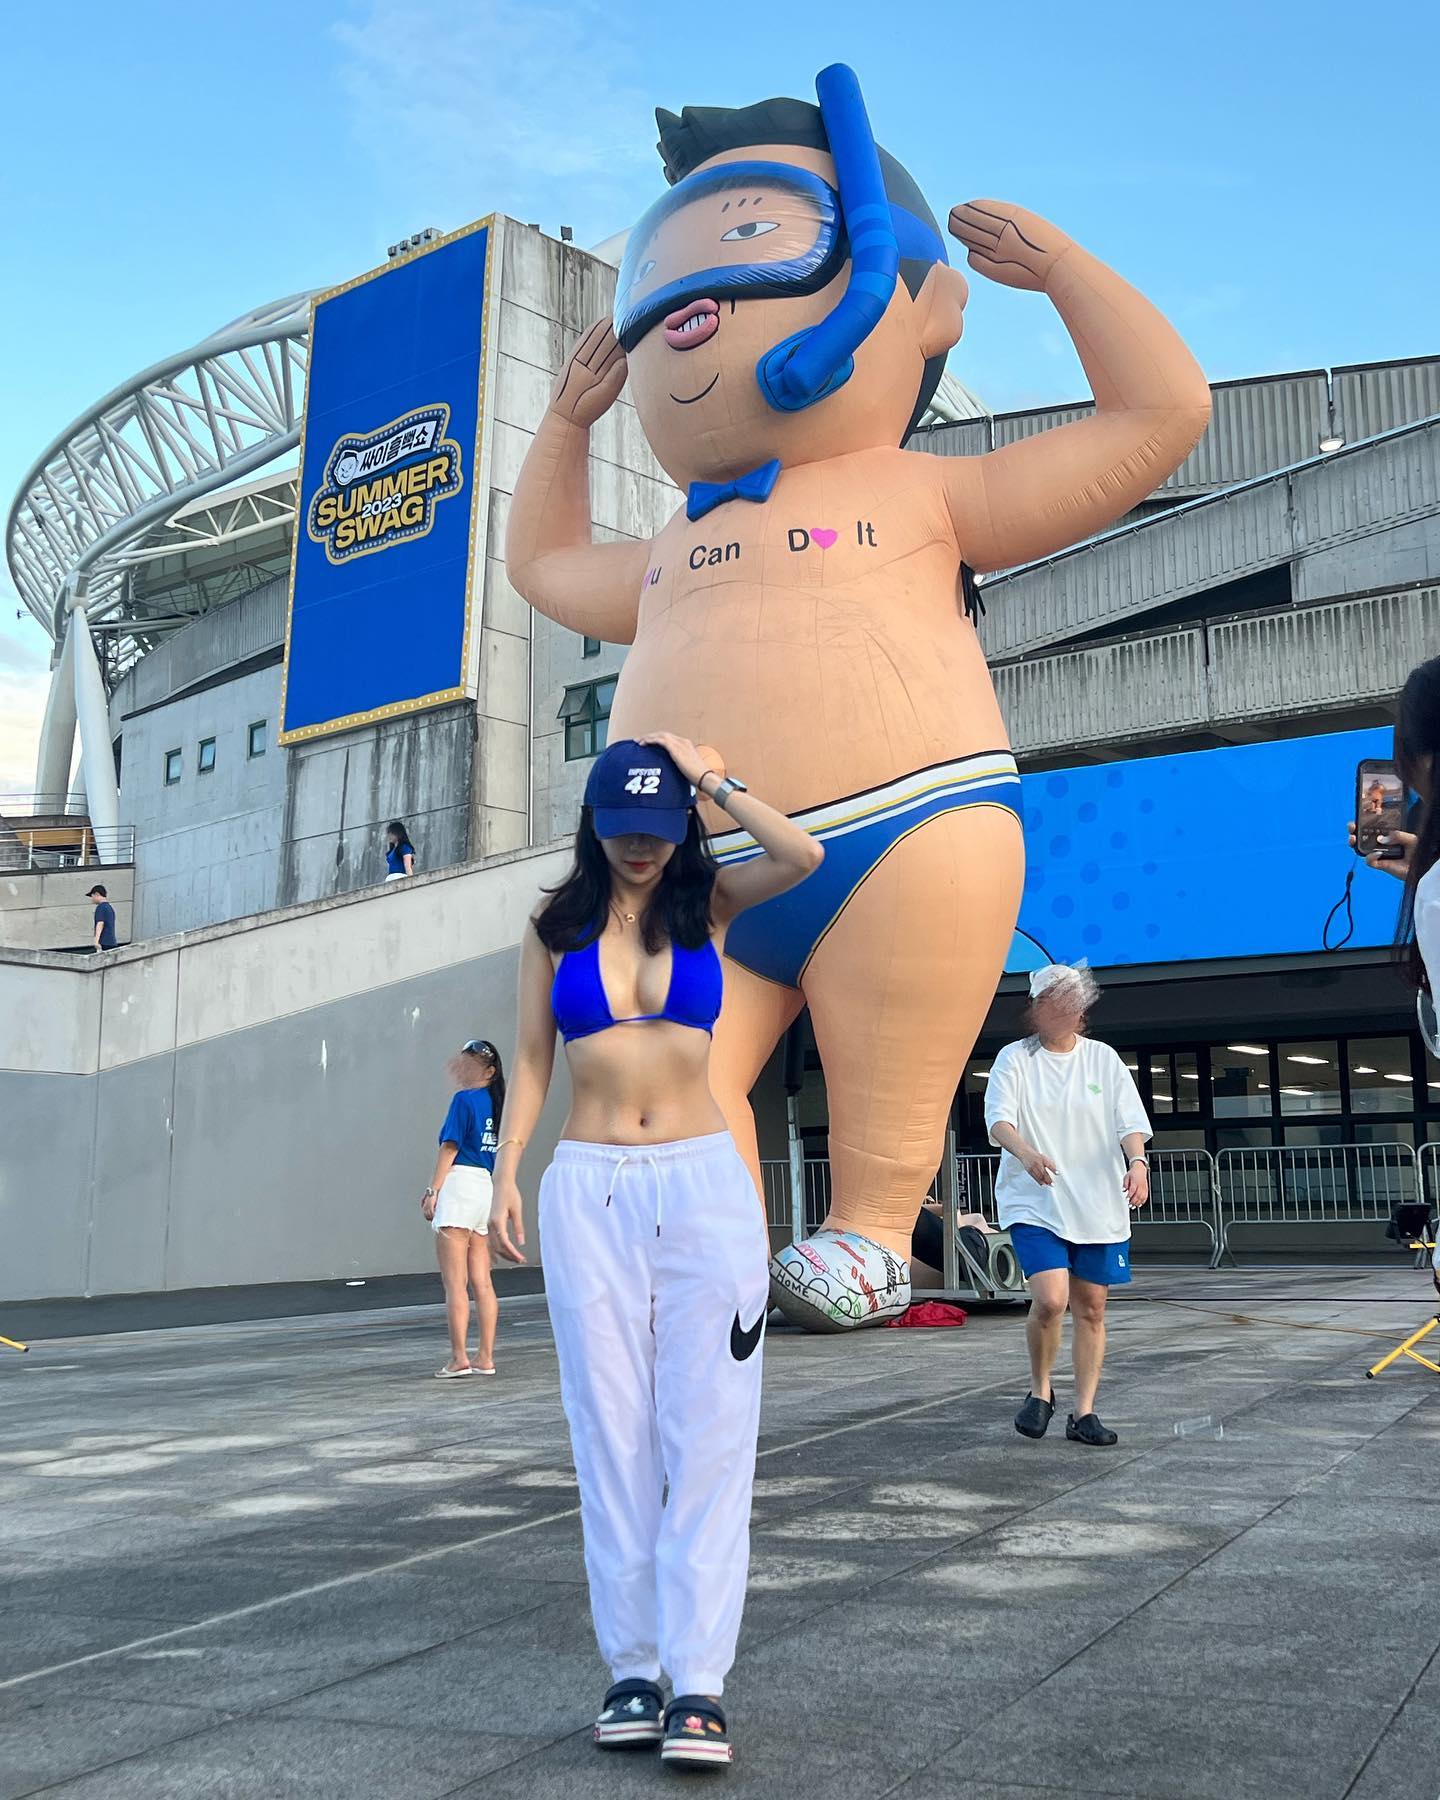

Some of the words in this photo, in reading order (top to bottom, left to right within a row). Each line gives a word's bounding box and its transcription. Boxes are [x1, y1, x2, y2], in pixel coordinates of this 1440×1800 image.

[317, 456, 449, 527] SUMMER
[361, 492, 402, 519] 2023
[335, 495, 424, 549] SWAG
[688, 541, 741, 571] Can
[857, 520, 878, 548] It
[624, 776, 661, 795] 42
